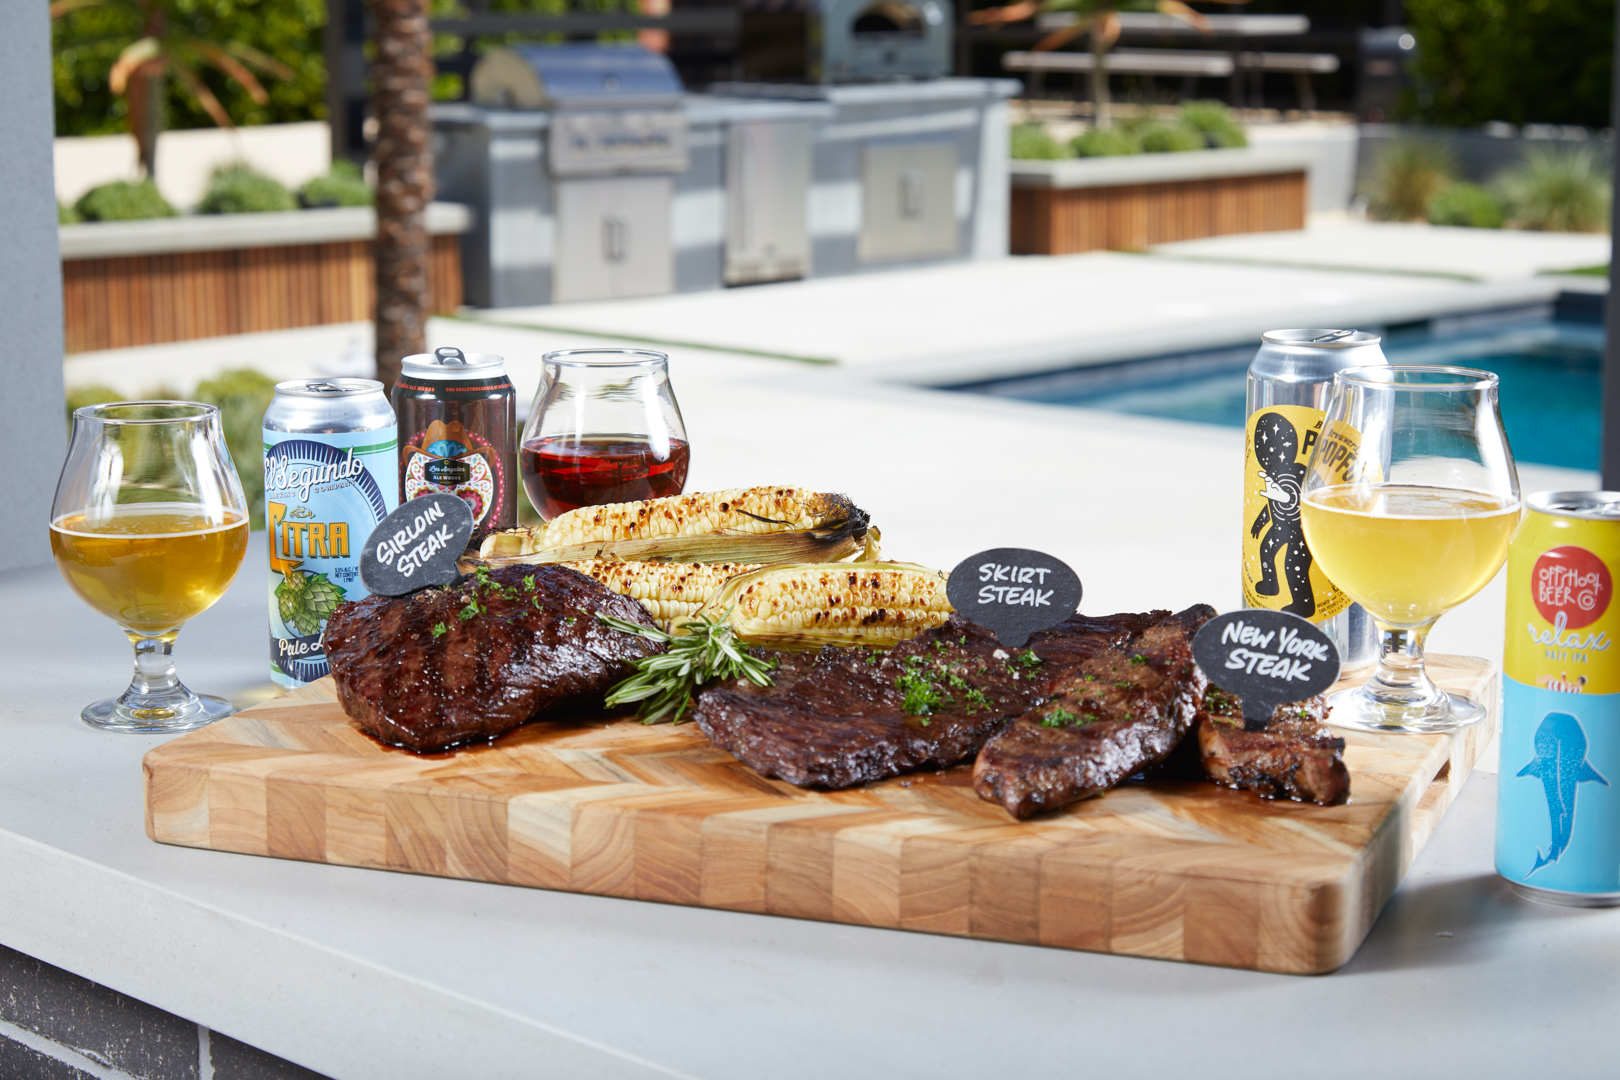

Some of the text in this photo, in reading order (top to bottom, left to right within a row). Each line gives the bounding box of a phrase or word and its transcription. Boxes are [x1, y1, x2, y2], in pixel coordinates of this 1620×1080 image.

[275, 444, 364, 503] Segundo
[314, 476, 358, 493] COMPANY
[268, 500, 350, 576] CITRA
[376, 501, 445, 566] SIRLOIN
[396, 524, 454, 578] STEAK
[979, 563, 1052, 585] SKIRT
[977, 585, 1055, 608] STEAK
[1538, 580, 1577, 607] BEER
[278, 637, 310, 656] Pale
[1221, 620, 1329, 662] NEW YORK
[1527, 610, 1612, 652] relax
[1224, 648, 1312, 682] STEAK
[1545, 650, 1588, 664] HAZY IPA
